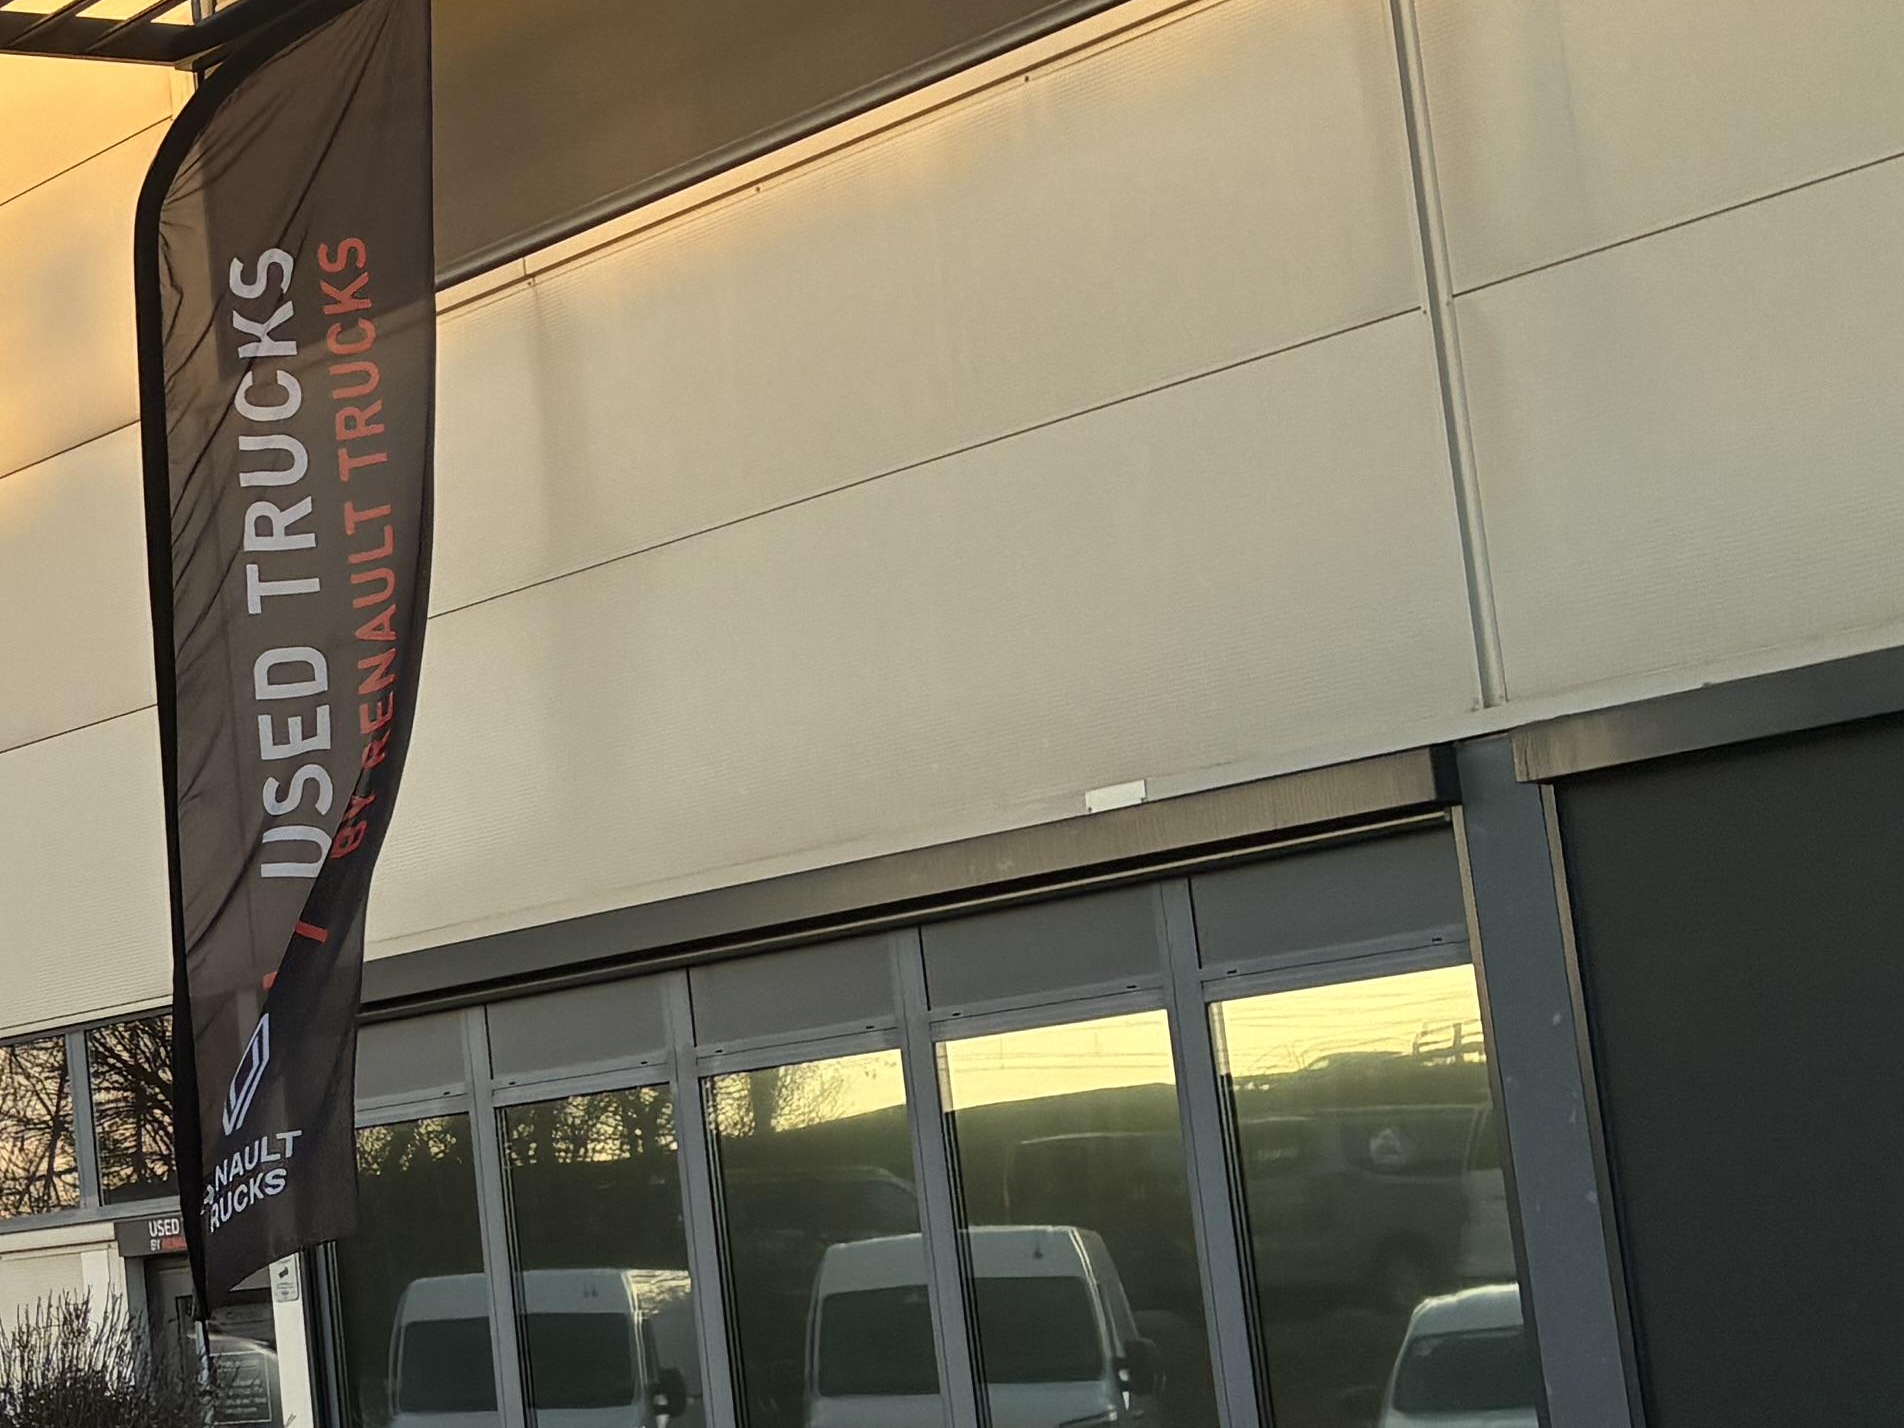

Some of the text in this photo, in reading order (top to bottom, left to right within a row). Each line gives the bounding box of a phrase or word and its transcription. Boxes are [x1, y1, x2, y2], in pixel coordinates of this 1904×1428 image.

[228, 247, 334, 879] USED TRUCKS
[317, 236, 398, 860] BY RENAULT TRUCKS
[149, 1218, 180, 1237] USED
[200, 1168, 287, 1233] RUCKS
